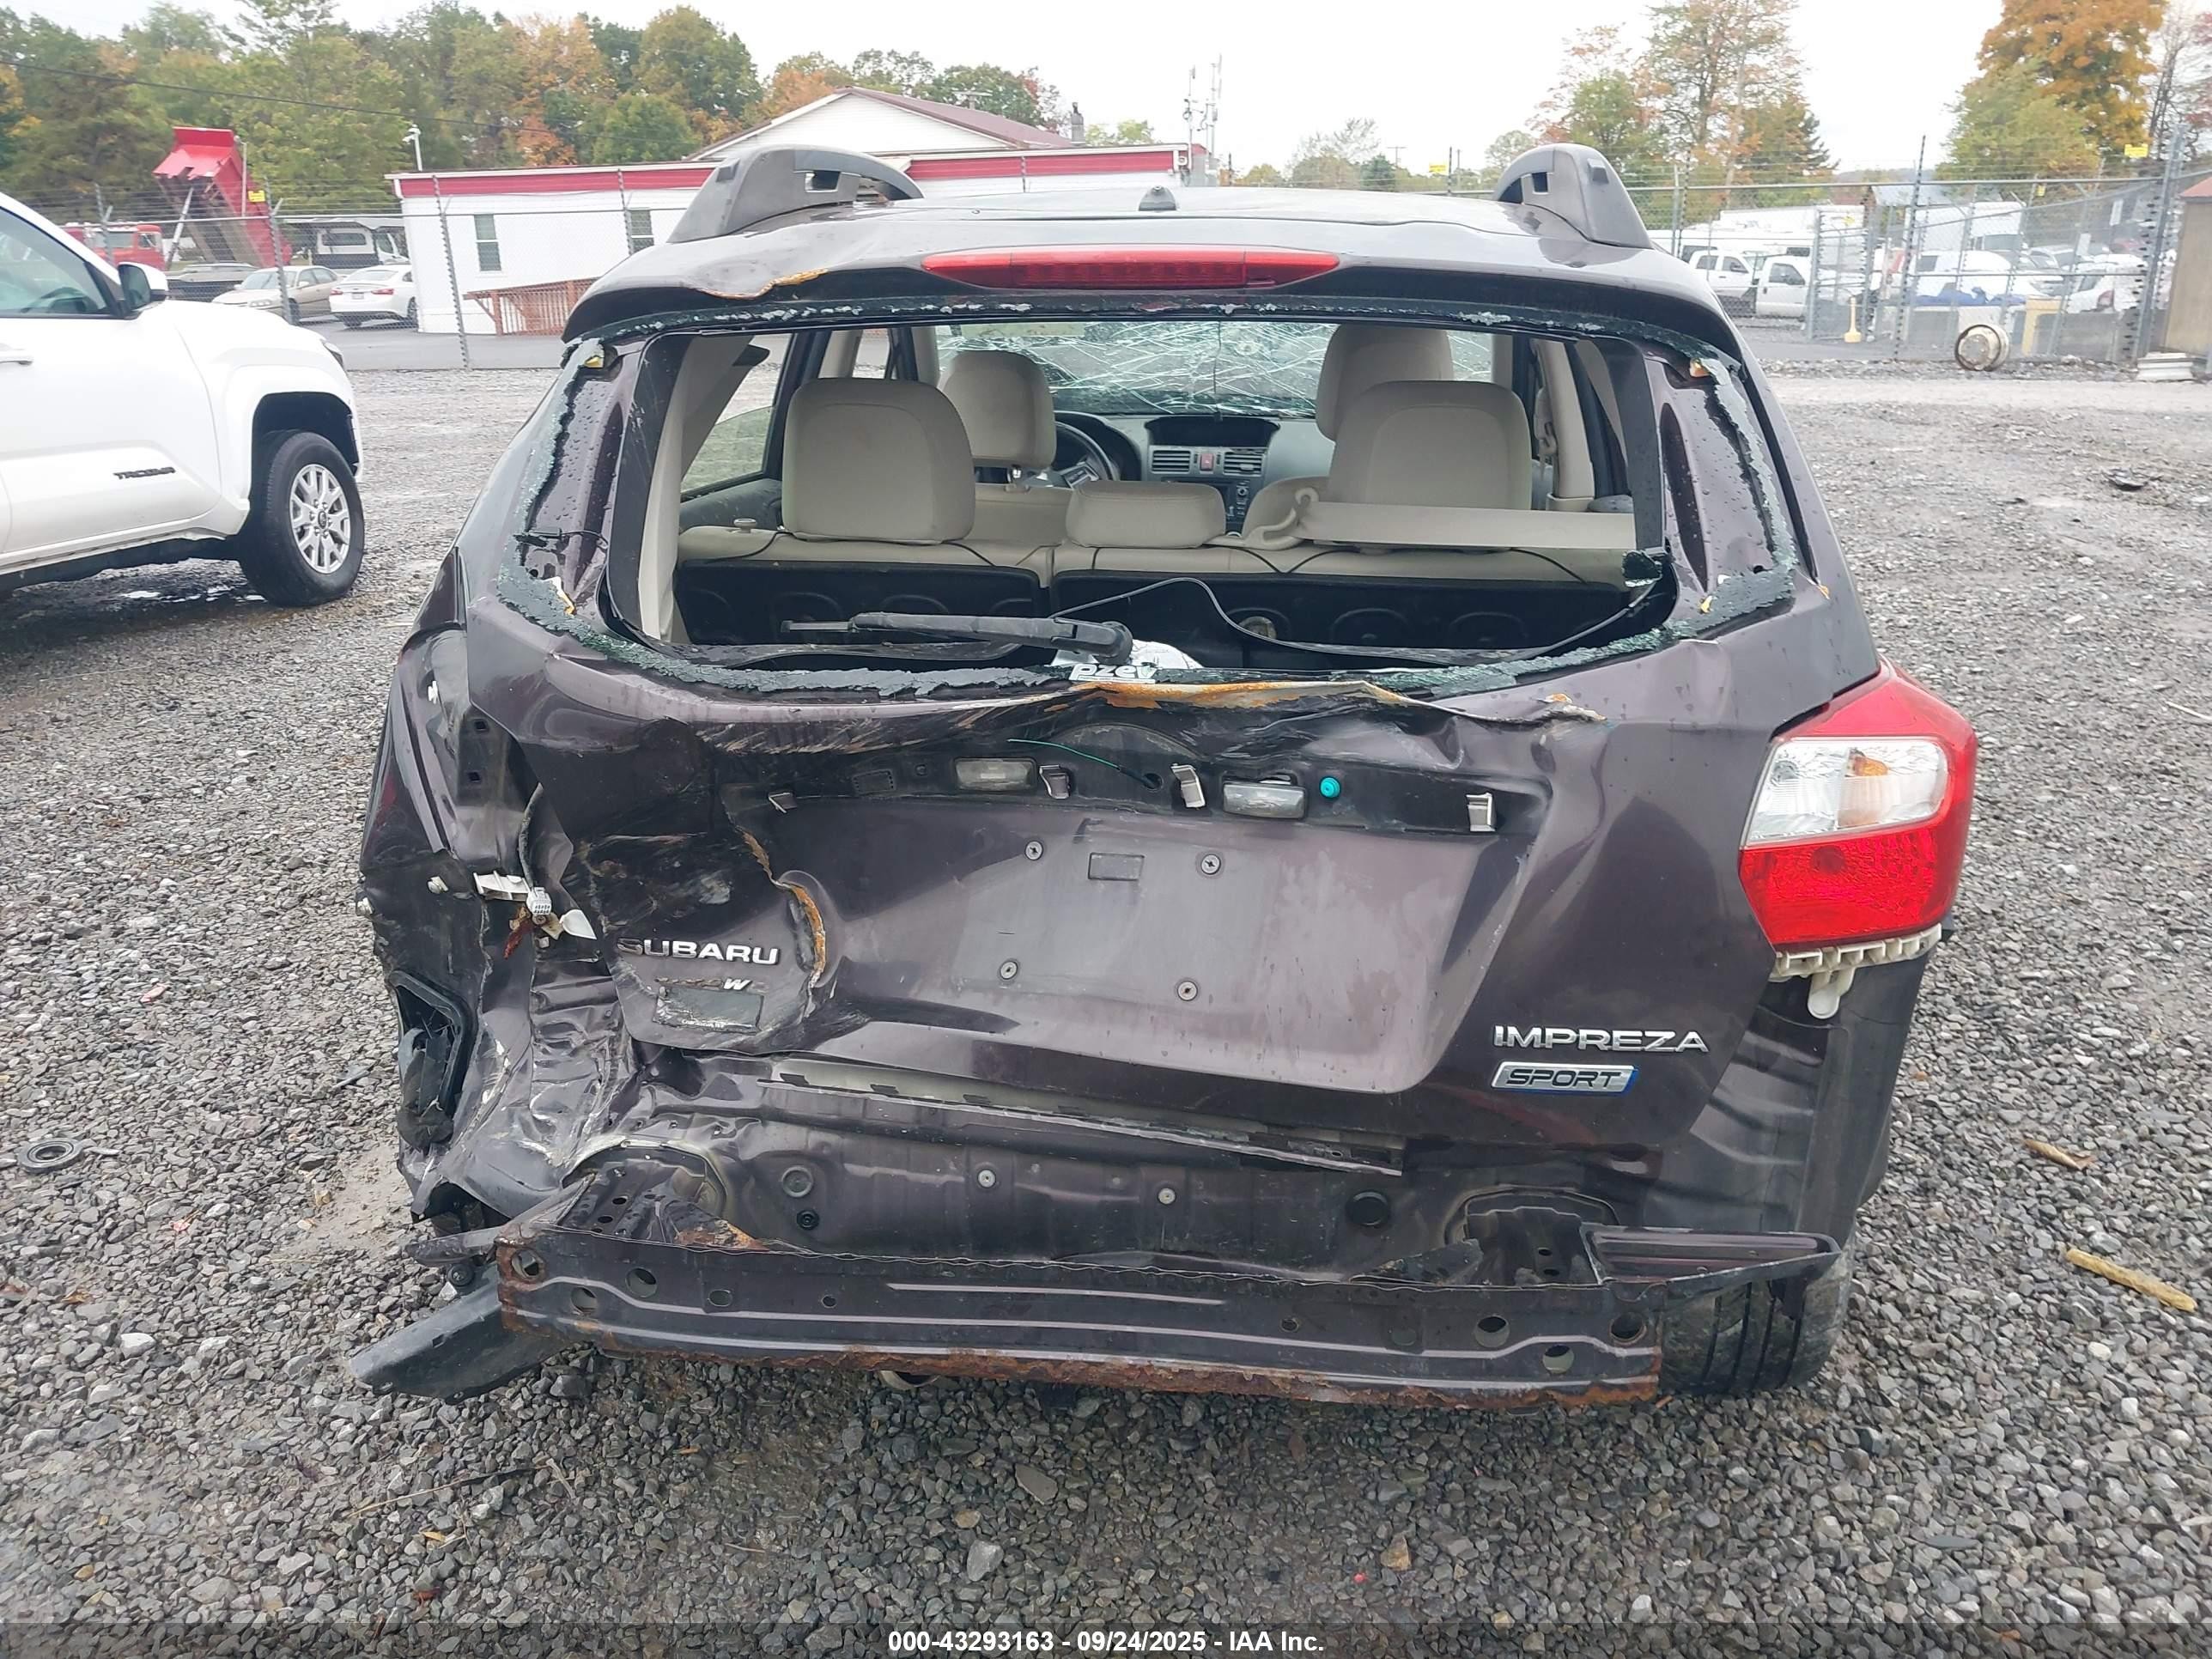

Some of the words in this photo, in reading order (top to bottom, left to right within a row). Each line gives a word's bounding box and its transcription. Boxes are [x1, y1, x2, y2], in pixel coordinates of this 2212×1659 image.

[617, 937, 781, 966] SUBARU
[1493, 1024, 1710, 1054] IMPREZA
[1505, 1068, 1622, 1088] SPORT
